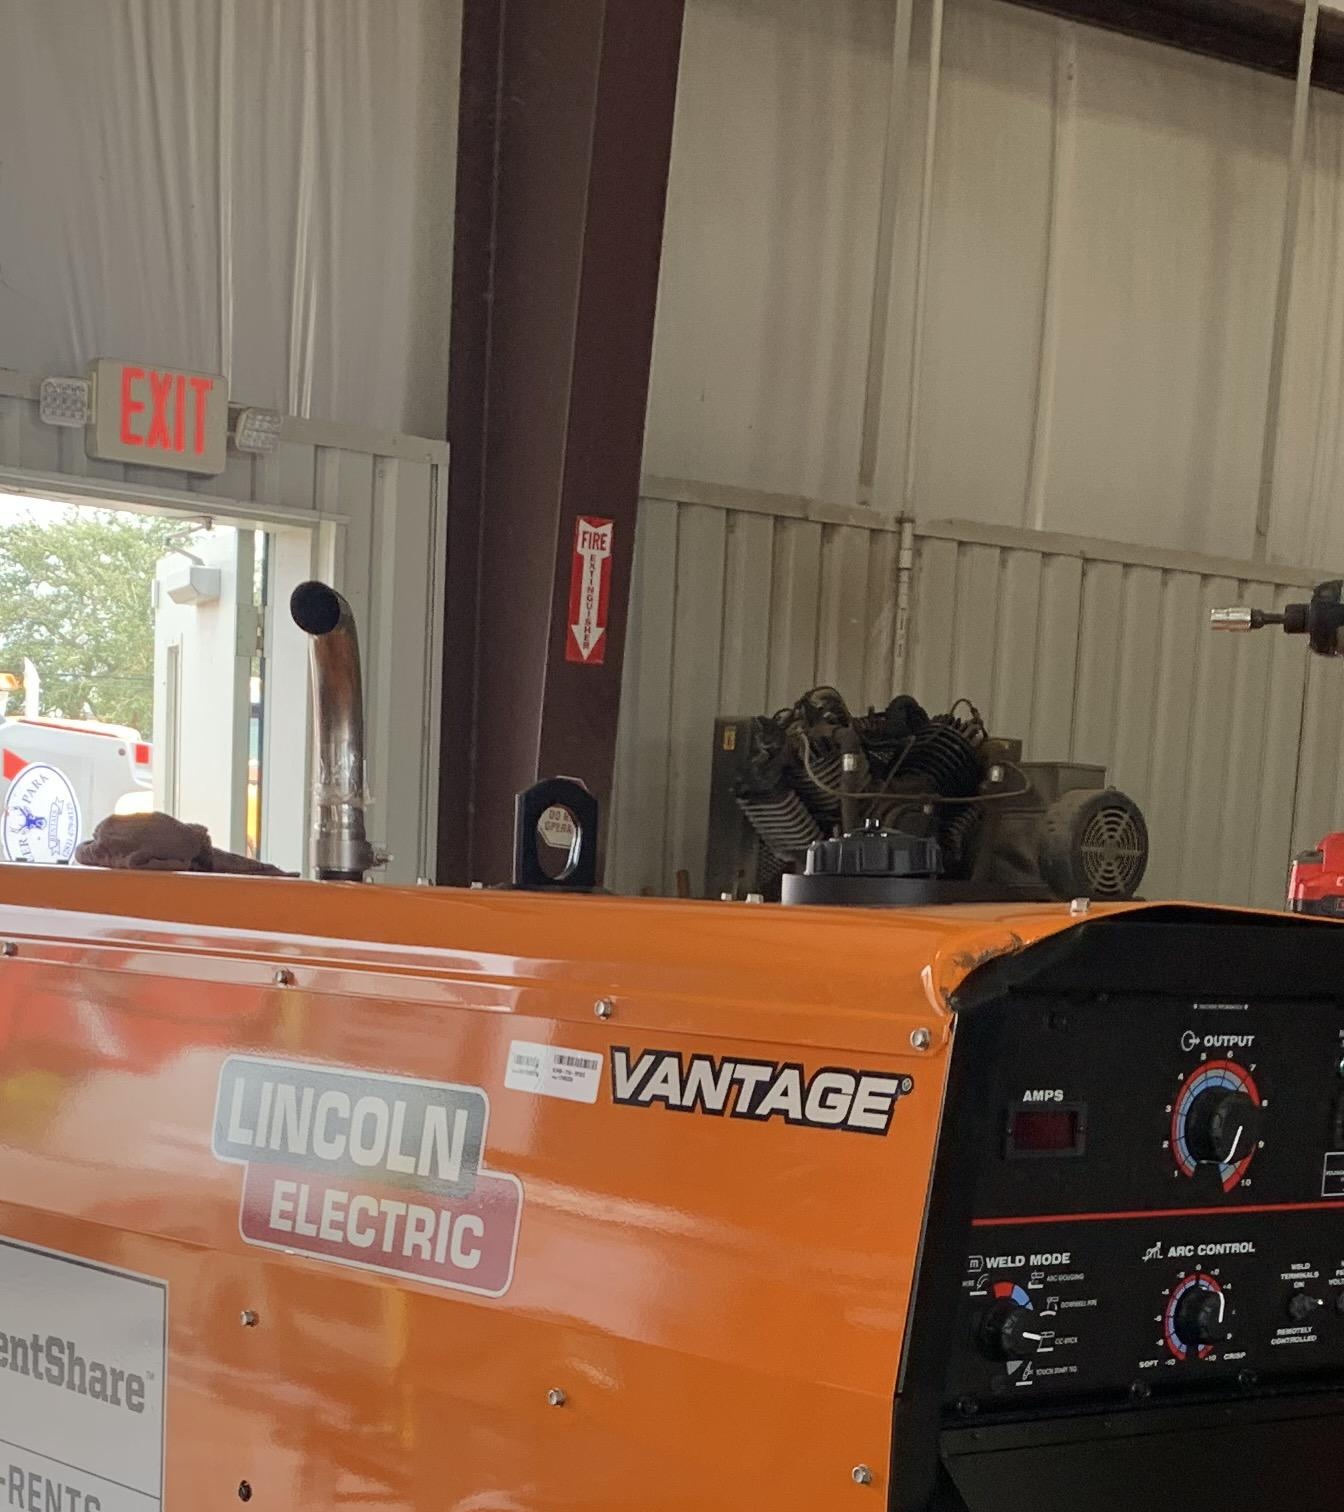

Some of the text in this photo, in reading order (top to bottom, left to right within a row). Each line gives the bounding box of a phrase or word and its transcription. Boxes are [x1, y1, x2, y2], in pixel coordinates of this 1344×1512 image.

[119, 366, 214, 455] EXIT
[581, 530, 608, 550] FIRE
[583, 554, 596, 649] EXTINGUISHER
[545, 821, 572, 833] OPERA
[1203, 1035, 1255, 1047] OUTPUT
[1023, 1089, 1064, 1102] AMPS
[223, 1080, 469, 1183] LINCOLN
[268, 1191, 486, 1271] ELECTRIC
[1167, 1241, 1256, 1258] ARC CONTROL
[985, 1252, 1071, 1269] WELD MODE
